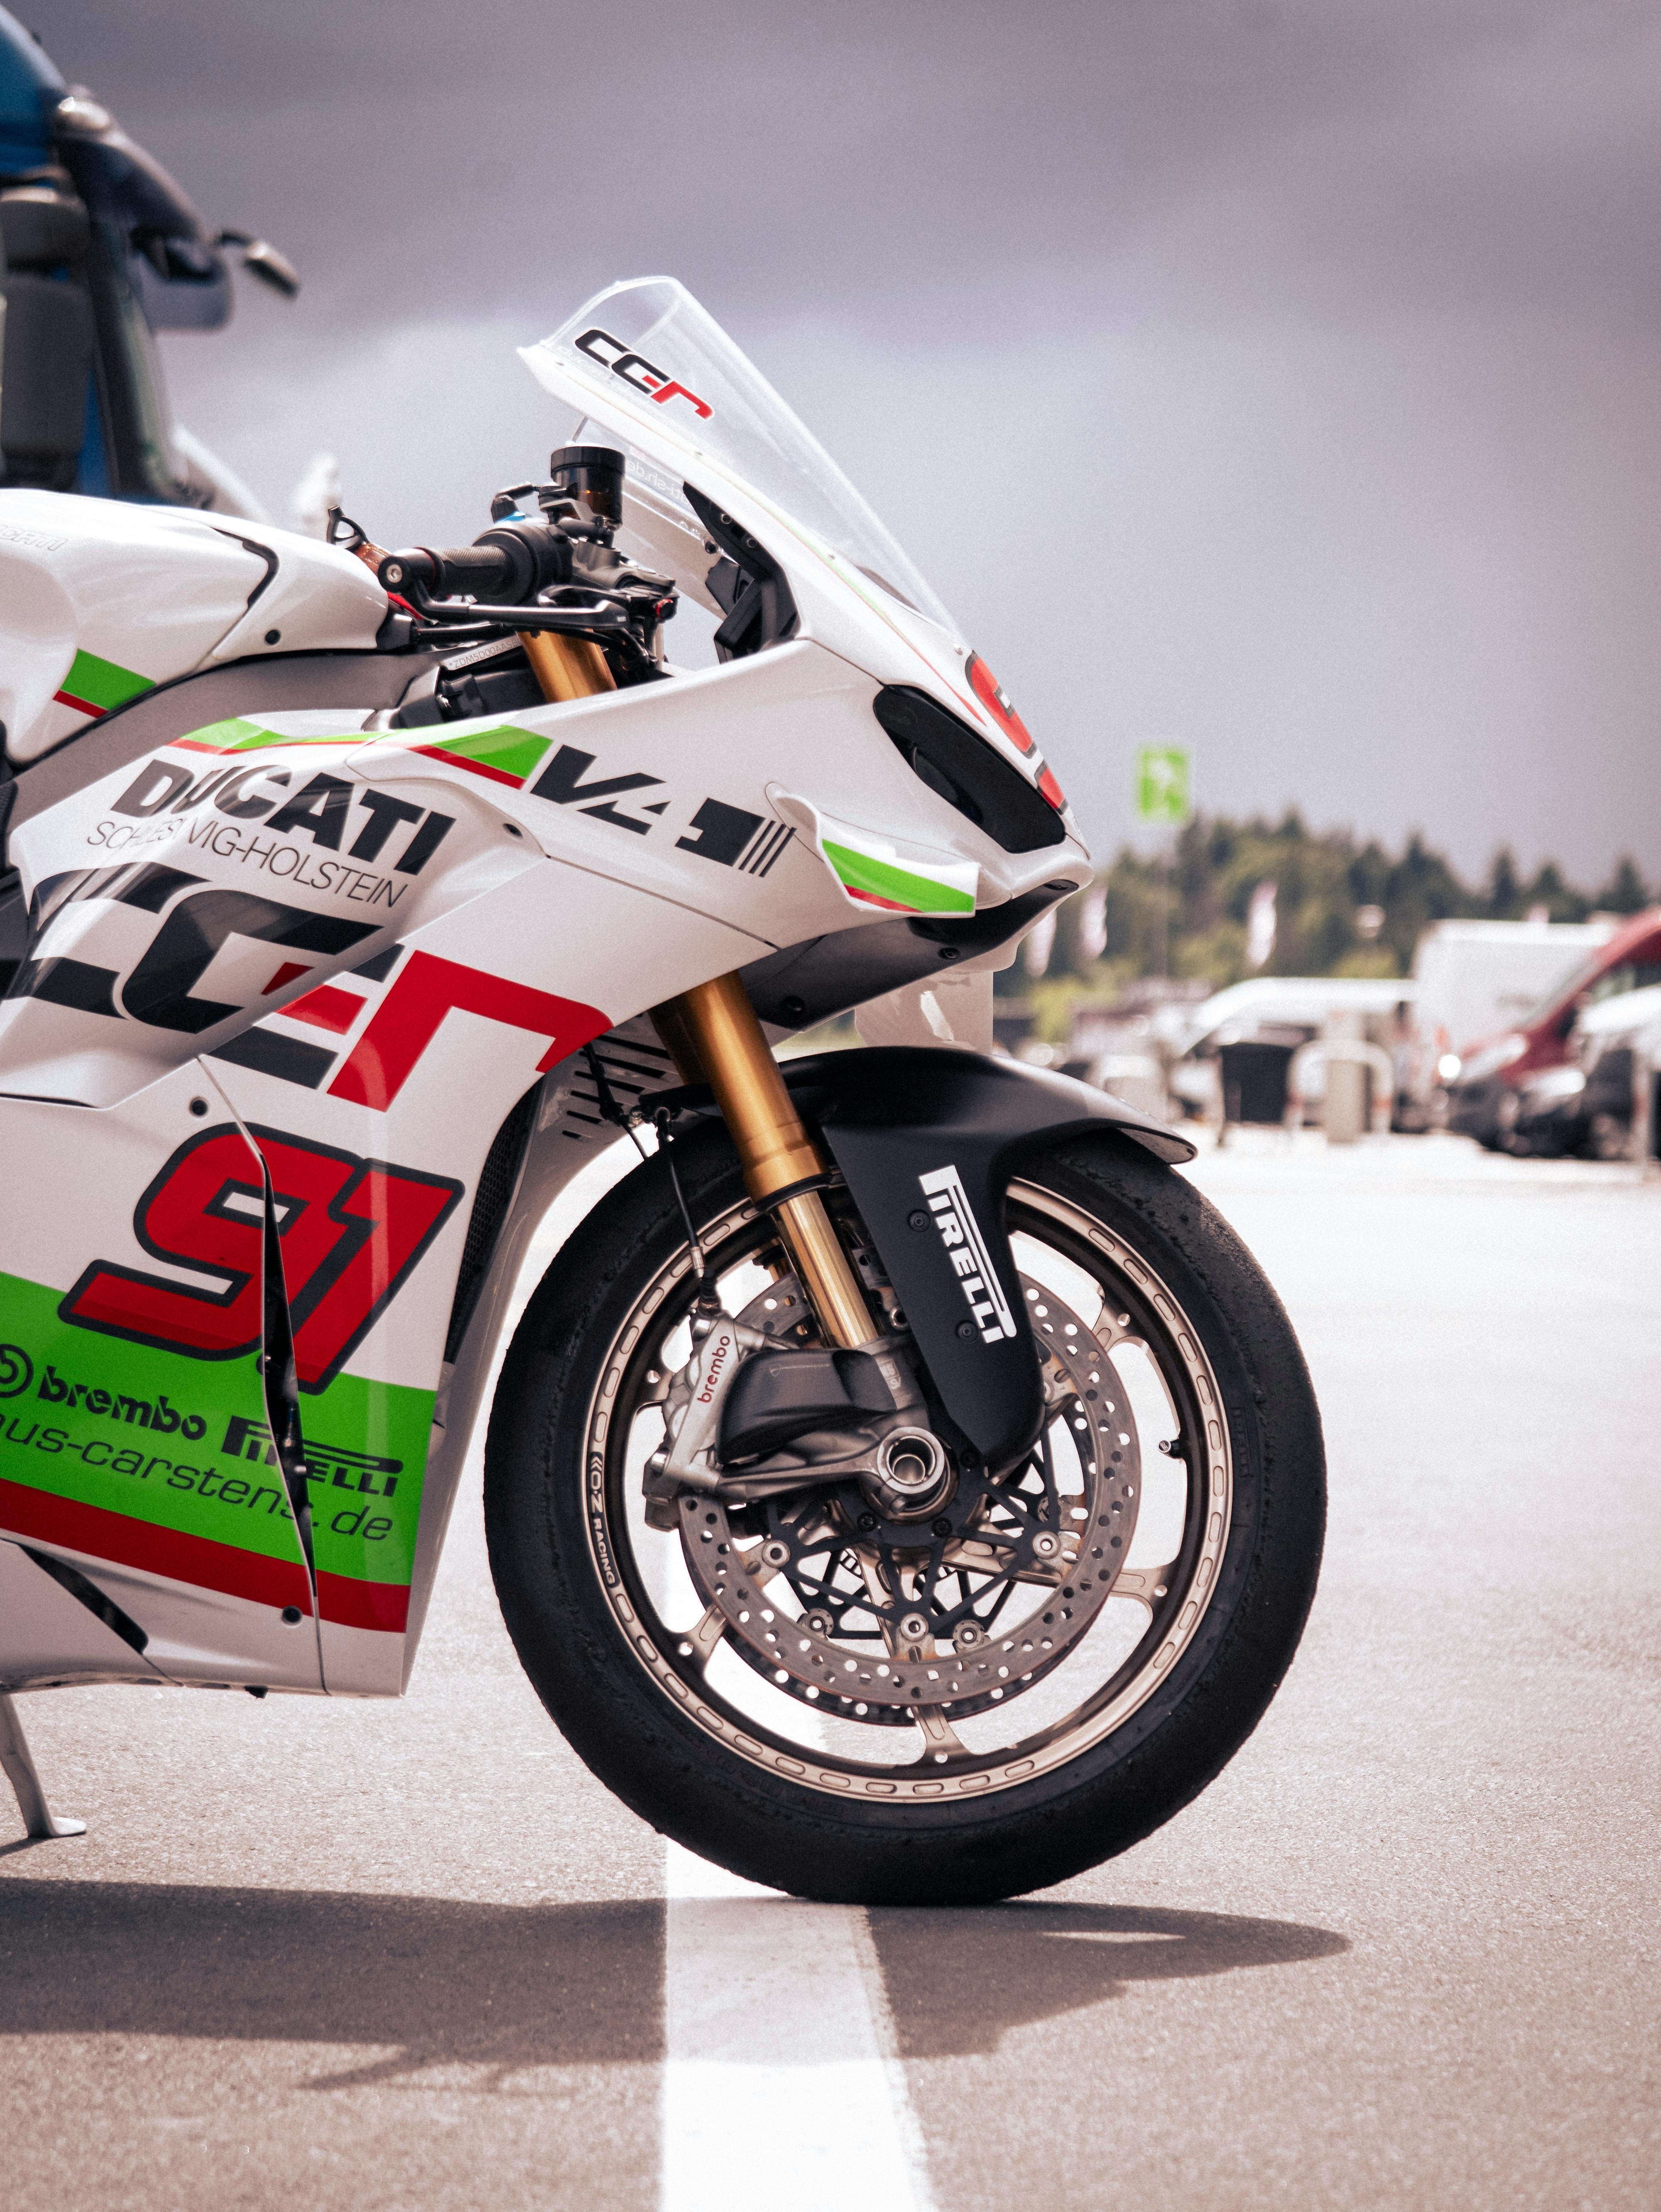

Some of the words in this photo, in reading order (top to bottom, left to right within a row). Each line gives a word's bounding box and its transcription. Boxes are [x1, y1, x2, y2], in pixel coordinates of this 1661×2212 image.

[0, 525, 69, 551] CATI
[110, 759, 457, 876] DUCATI
[58, 1121, 465, 1395] 91
[919, 1165, 1017, 1343] PIRELLI
[38, 1365, 207, 1441] brembo
[697, 1336, 731, 1403] brembo
[0, 1414, 393, 1541] us-carstens.de
[594, 1518, 616, 1585] RACING
